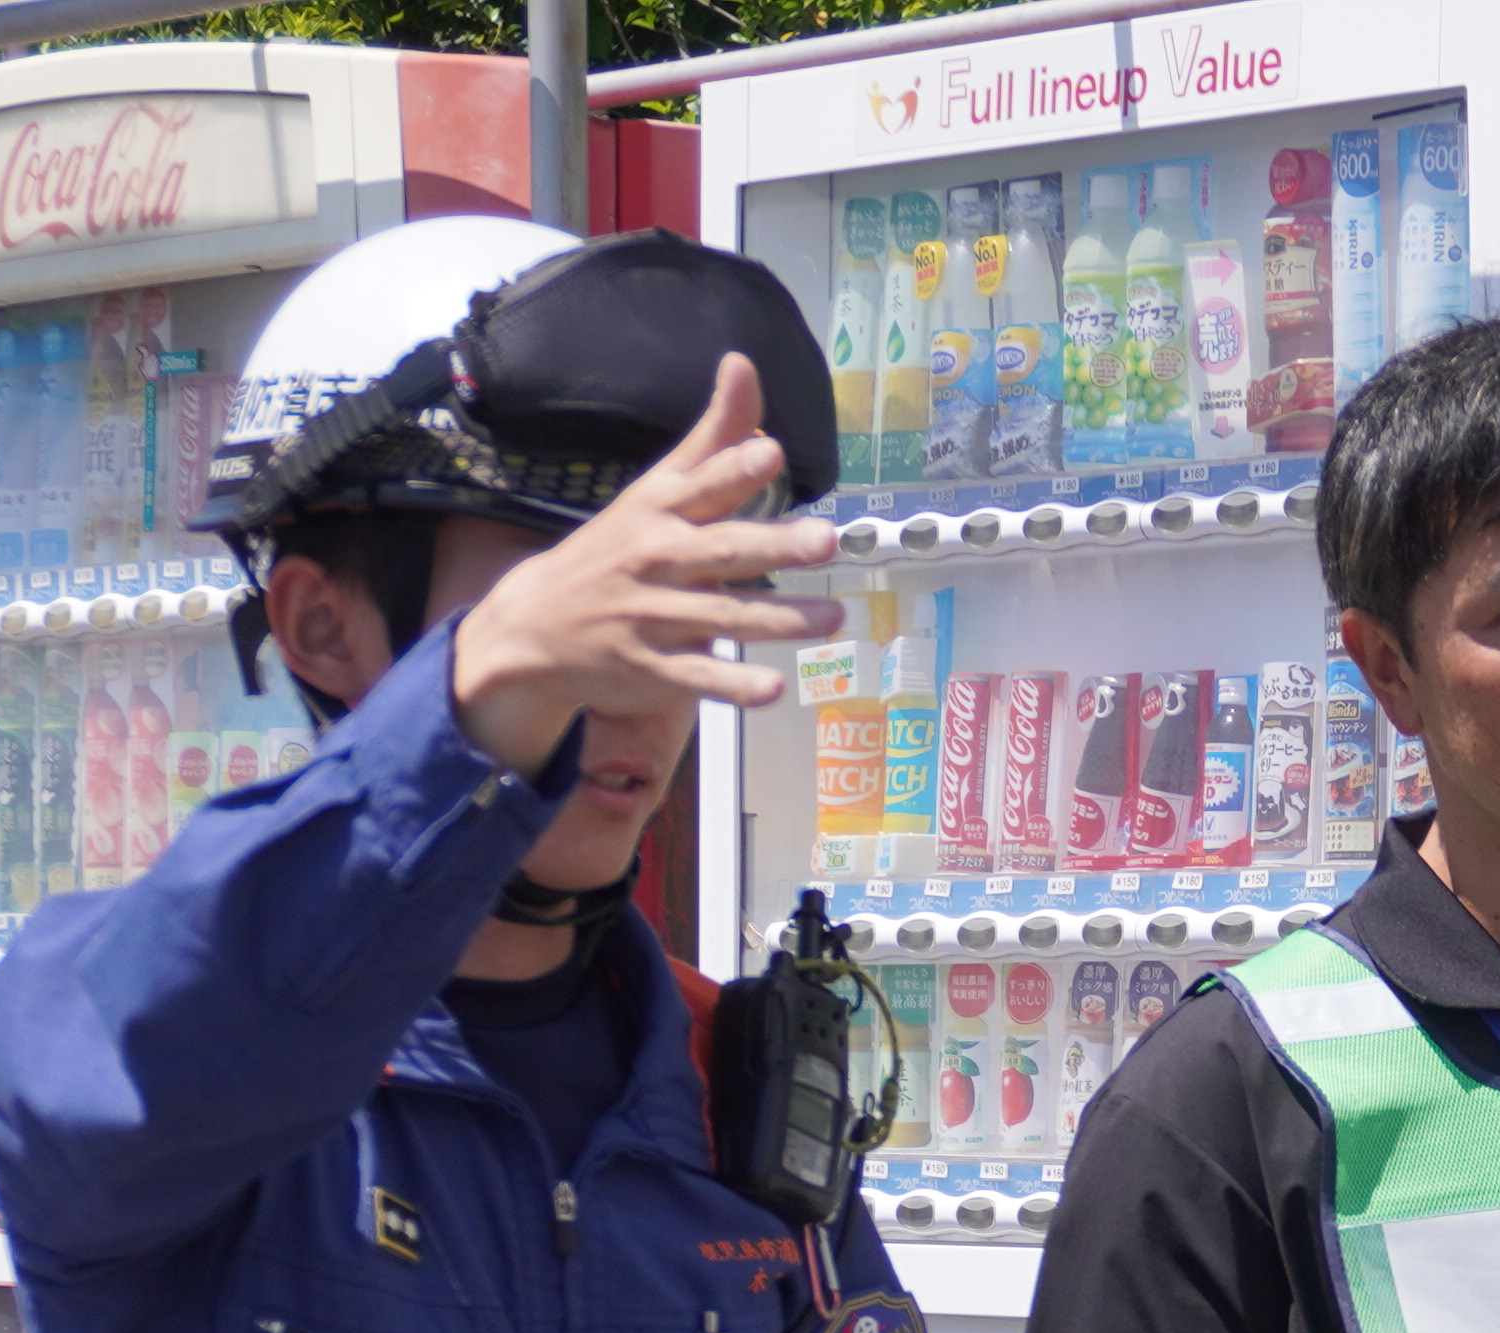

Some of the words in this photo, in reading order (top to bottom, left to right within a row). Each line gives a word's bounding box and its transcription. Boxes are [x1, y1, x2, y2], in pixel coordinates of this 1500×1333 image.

[939, 57, 1014, 128] Full
[1029, 65, 1148, 118] lineup
[1161, 25, 1282, 97] Value
[1244, 874, 1266, 884] ¥150
[1310, 873, 1331, 883] ¥130
